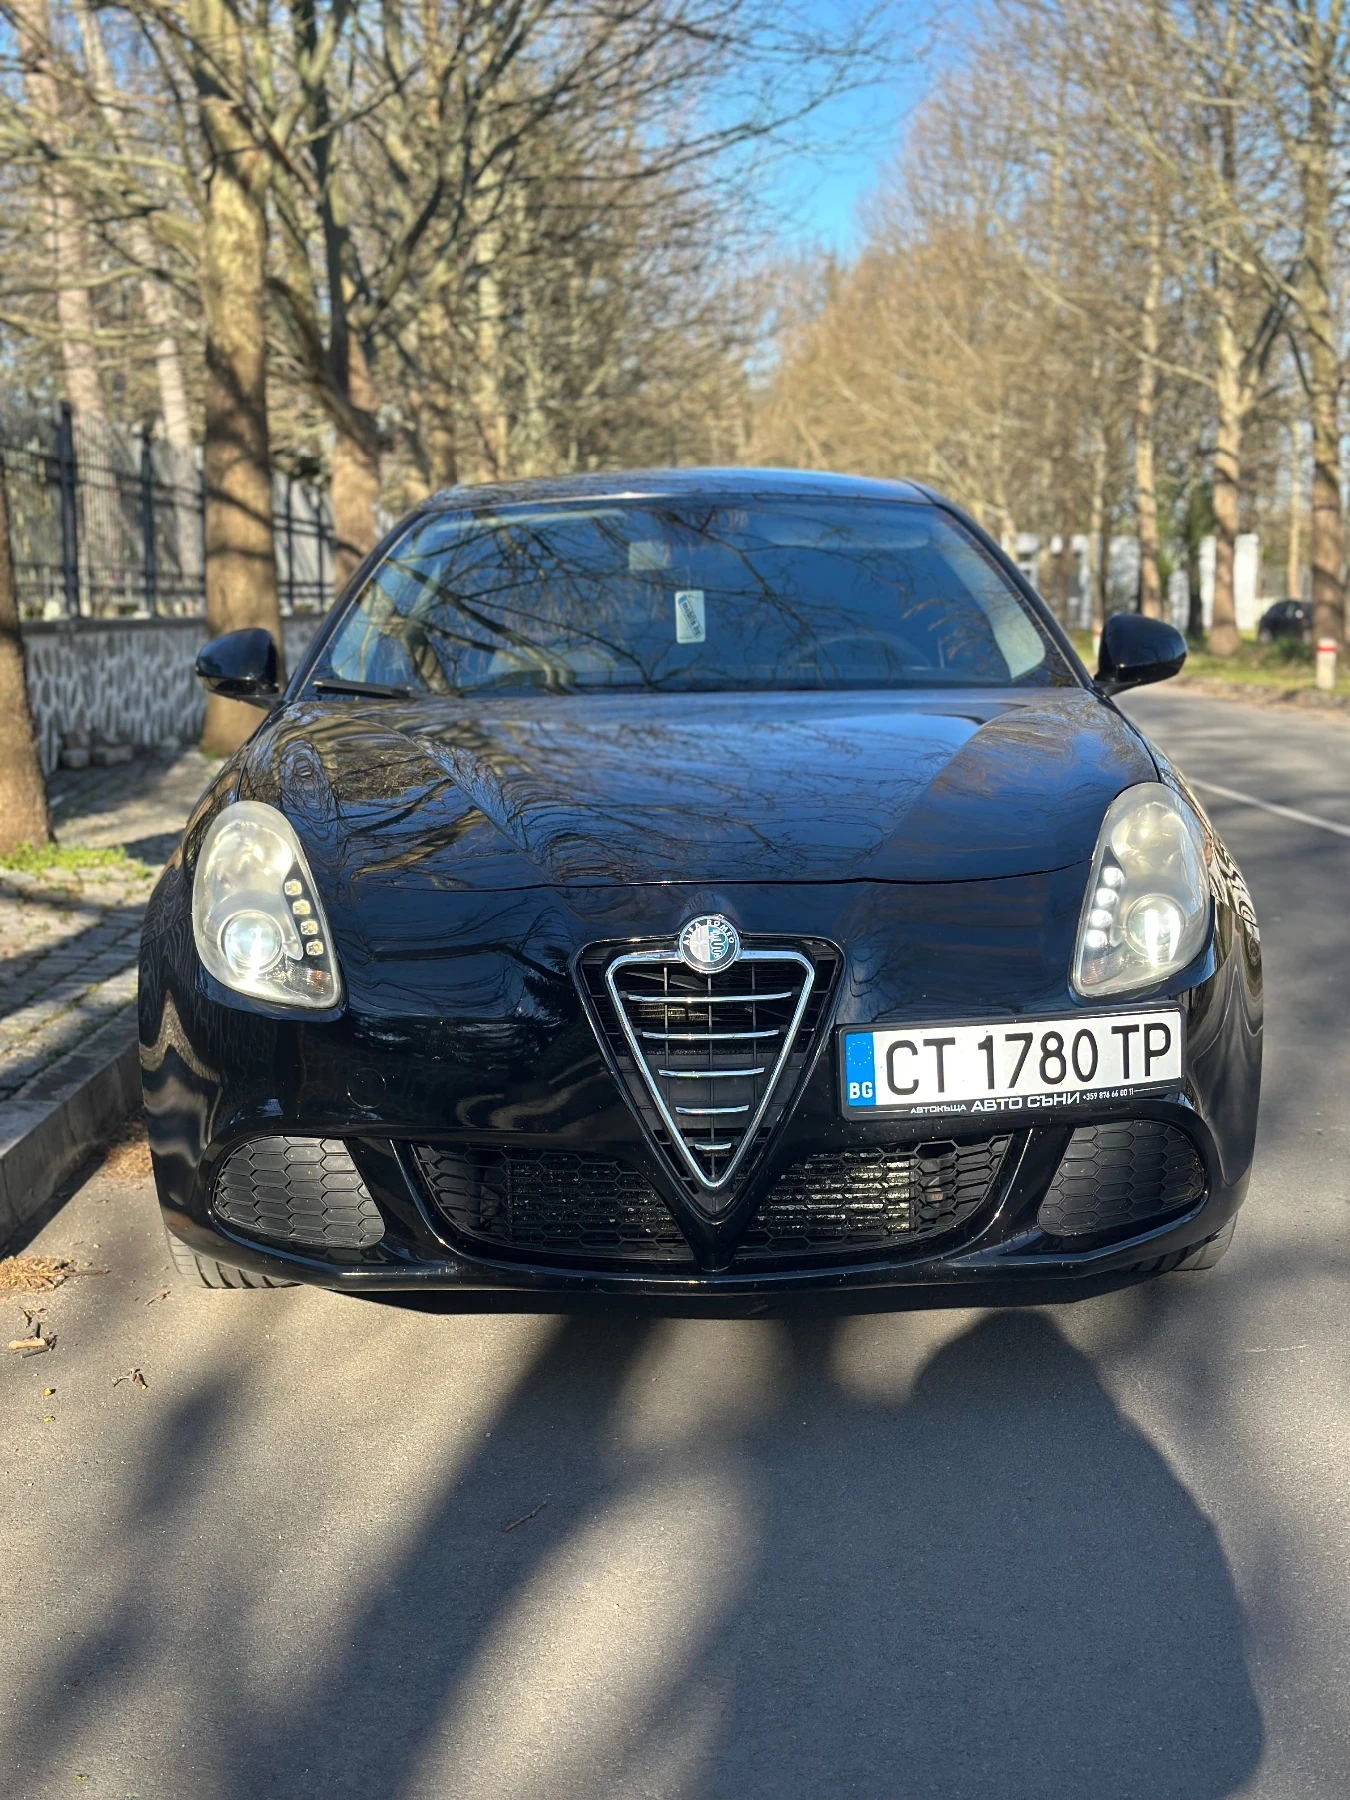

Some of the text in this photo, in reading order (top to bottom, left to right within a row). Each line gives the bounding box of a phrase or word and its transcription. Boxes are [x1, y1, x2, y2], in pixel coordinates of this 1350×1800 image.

[683, 919, 735, 946] ALFA ROMEO
[885, 1023, 1172, 1096] CT 1780 TP
[849, 1081, 873, 1099] BG
[910, 1104, 967, 1114] АВТОКЪЩА
[970, 1096, 1023, 1113] АВТО
[1027, 1091, 1081, 1108] СЪНИ
[1082, 1092, 1098, 1101] +359
